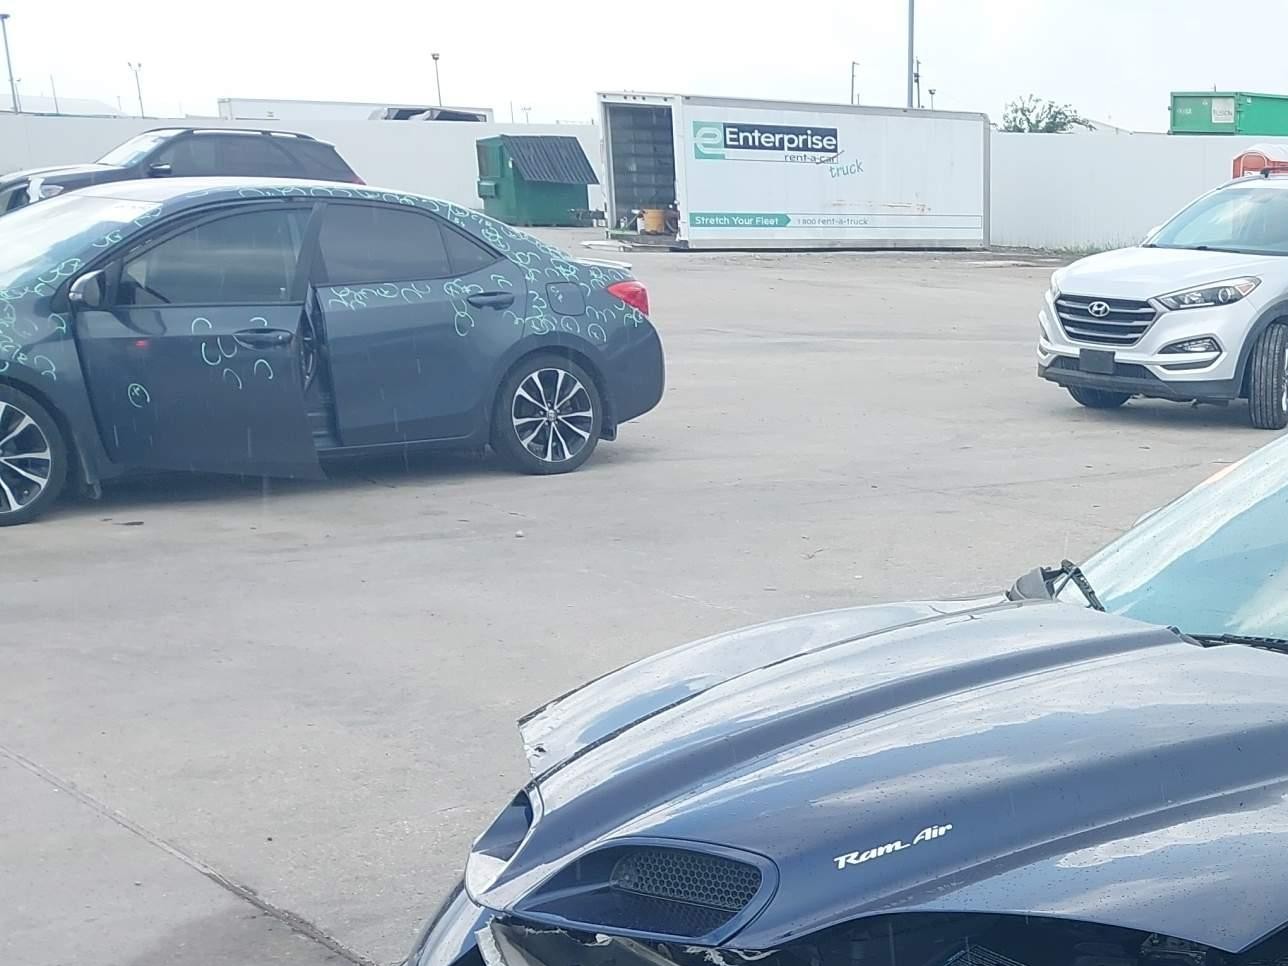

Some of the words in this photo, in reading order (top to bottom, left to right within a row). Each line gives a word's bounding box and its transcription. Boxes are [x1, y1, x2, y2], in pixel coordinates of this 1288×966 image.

[725, 127, 837, 151] Enterprise
[829, 159, 864, 178] truck
[695, 216, 729, 226] Stretch
[732, 216, 754, 226] Your
[755, 216, 779, 226] Fleet
[833, 840, 911, 869] Ram
[912, 824, 953, 845] Air
